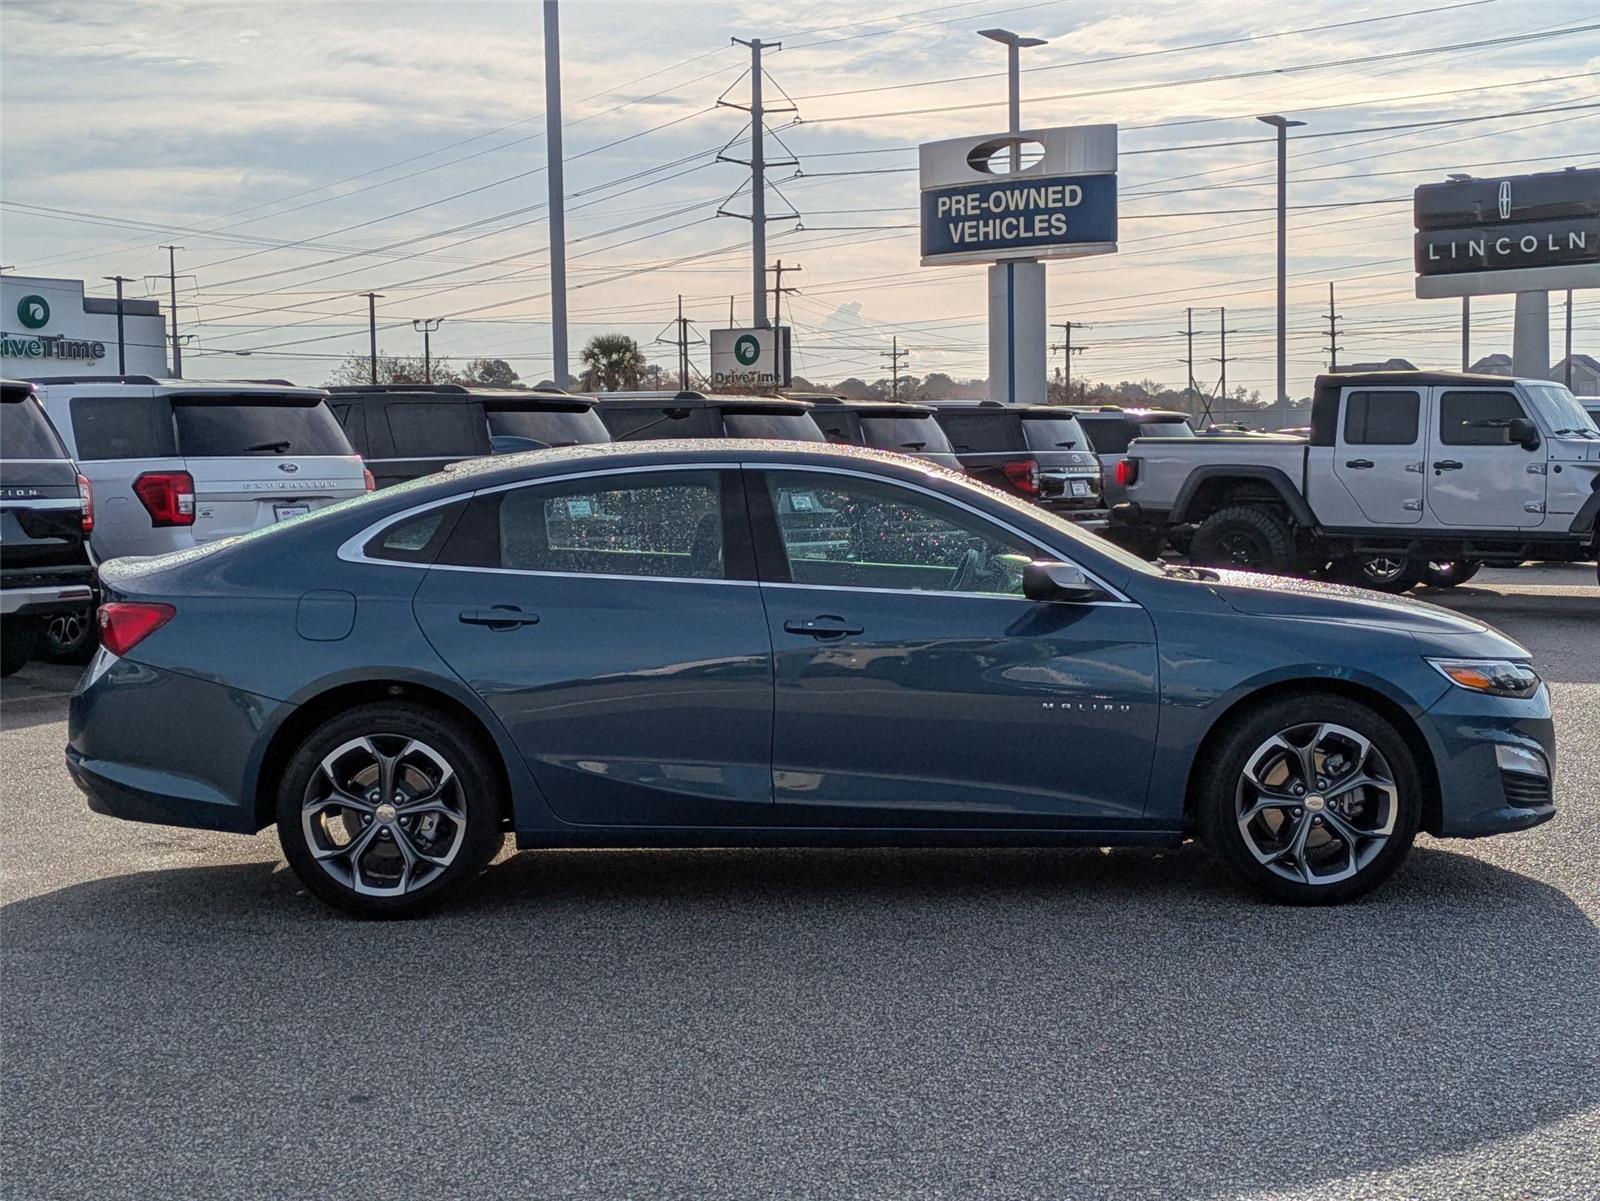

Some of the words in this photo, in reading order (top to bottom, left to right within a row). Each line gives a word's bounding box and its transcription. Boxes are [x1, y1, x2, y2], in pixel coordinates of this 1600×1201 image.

[937, 184, 1083, 219] PRE-OWNED
[948, 213, 1068, 244] VEHICLES
[1428, 231, 1587, 260] LINCOLN
[1042, 702, 1130, 712] MALIBU
